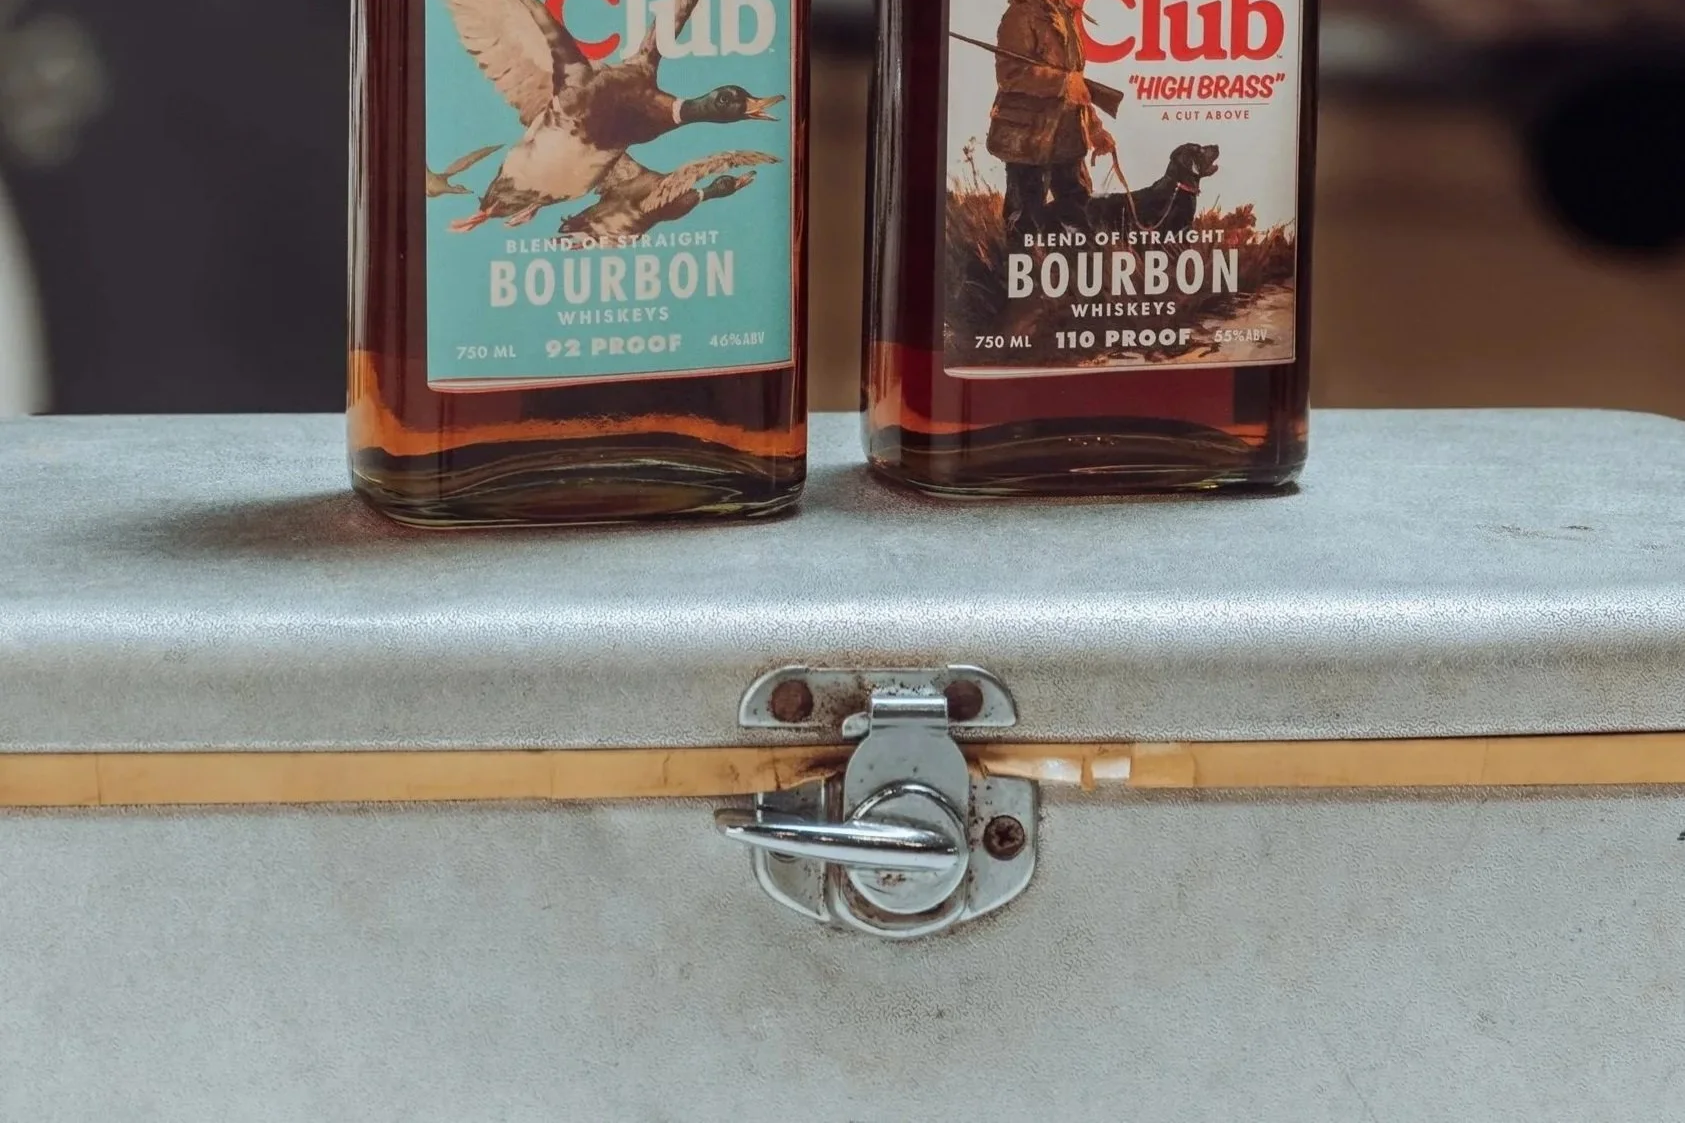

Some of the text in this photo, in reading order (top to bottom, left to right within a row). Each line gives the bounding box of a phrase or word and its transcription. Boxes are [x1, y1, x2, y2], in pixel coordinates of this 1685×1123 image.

[1161, 110, 1249, 120] A CUT ABOVE
[506, 231, 719, 253] BLEND OF STRAIGHT
[1024, 229, 1224, 247] BLEND OF STRAIGHT
[490, 250, 735, 307] BOURBON
[1008, 248, 1239, 299] BOURBON
[558, 306, 669, 325] WHISKEYS
[1071, 302, 1176, 317] WHISKEYS
[545, 335, 681, 358] 92 PROOF
[975, 335, 1032, 349] 750 ML
[1056, 328, 1191, 349] 110 PROOF
[456, 346, 516, 359] 750 ML
